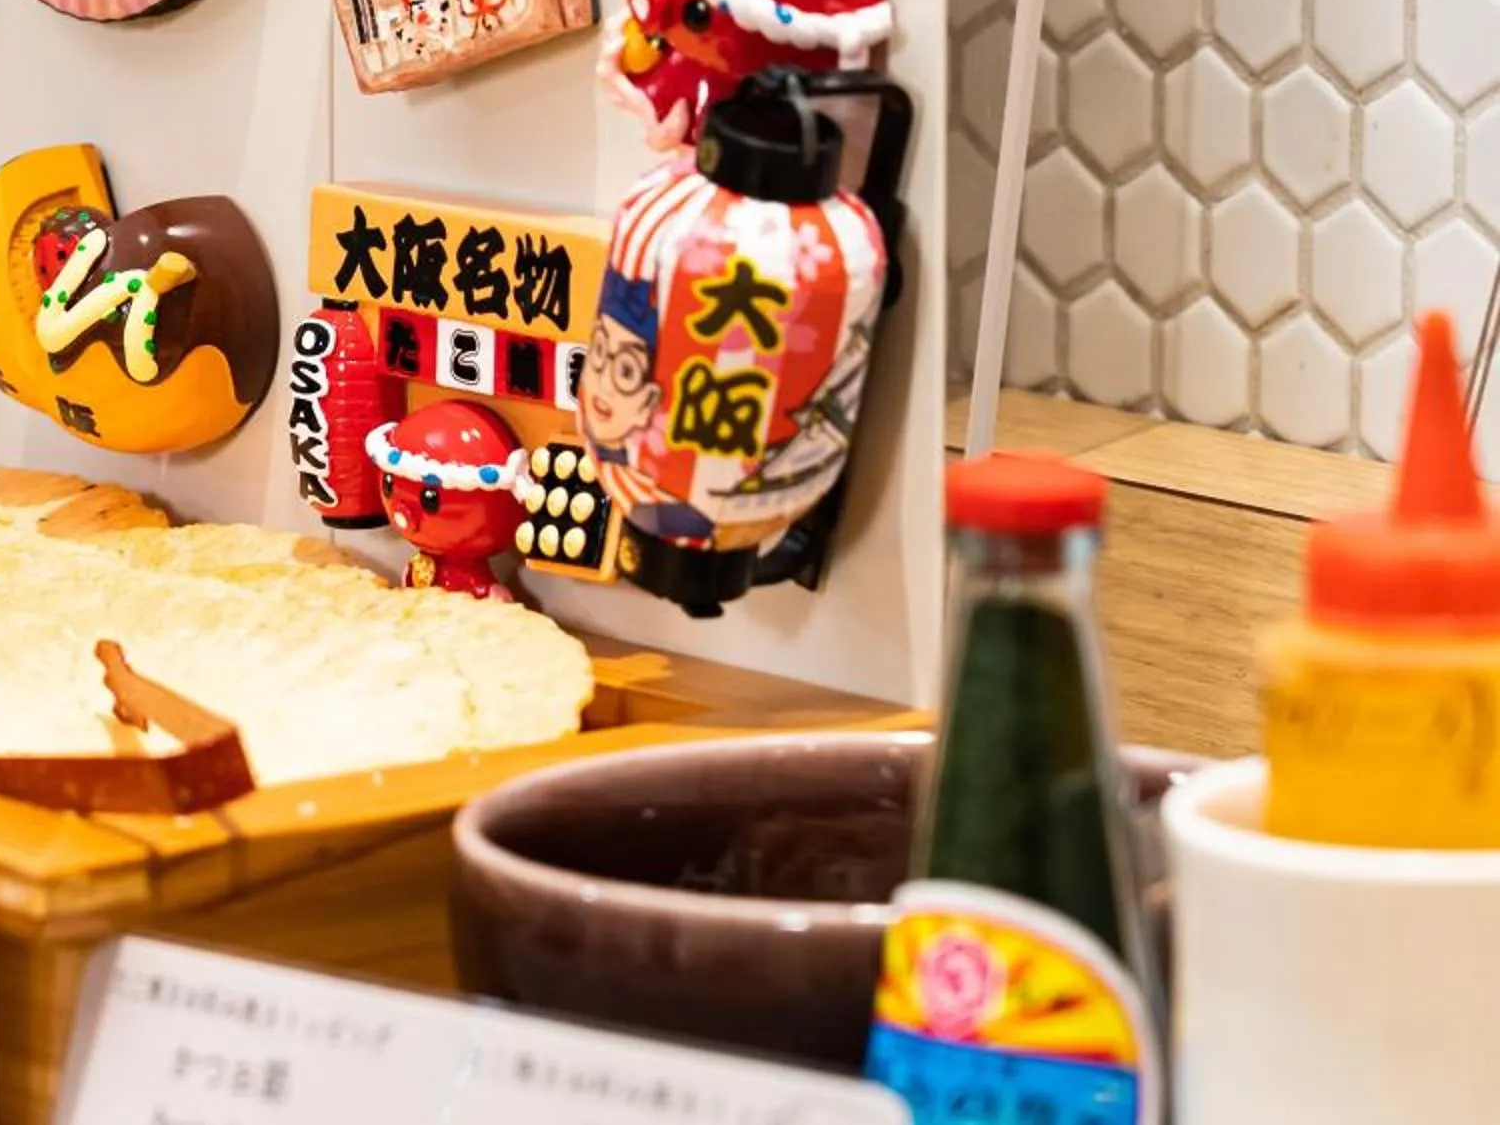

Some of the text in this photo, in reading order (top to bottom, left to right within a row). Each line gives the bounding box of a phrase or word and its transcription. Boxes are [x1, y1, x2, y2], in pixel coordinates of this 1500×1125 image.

[334, 204, 573, 332] 大阪名物
[671, 258, 790, 458] 大阪
[288, 321, 336, 506] OSAKA
